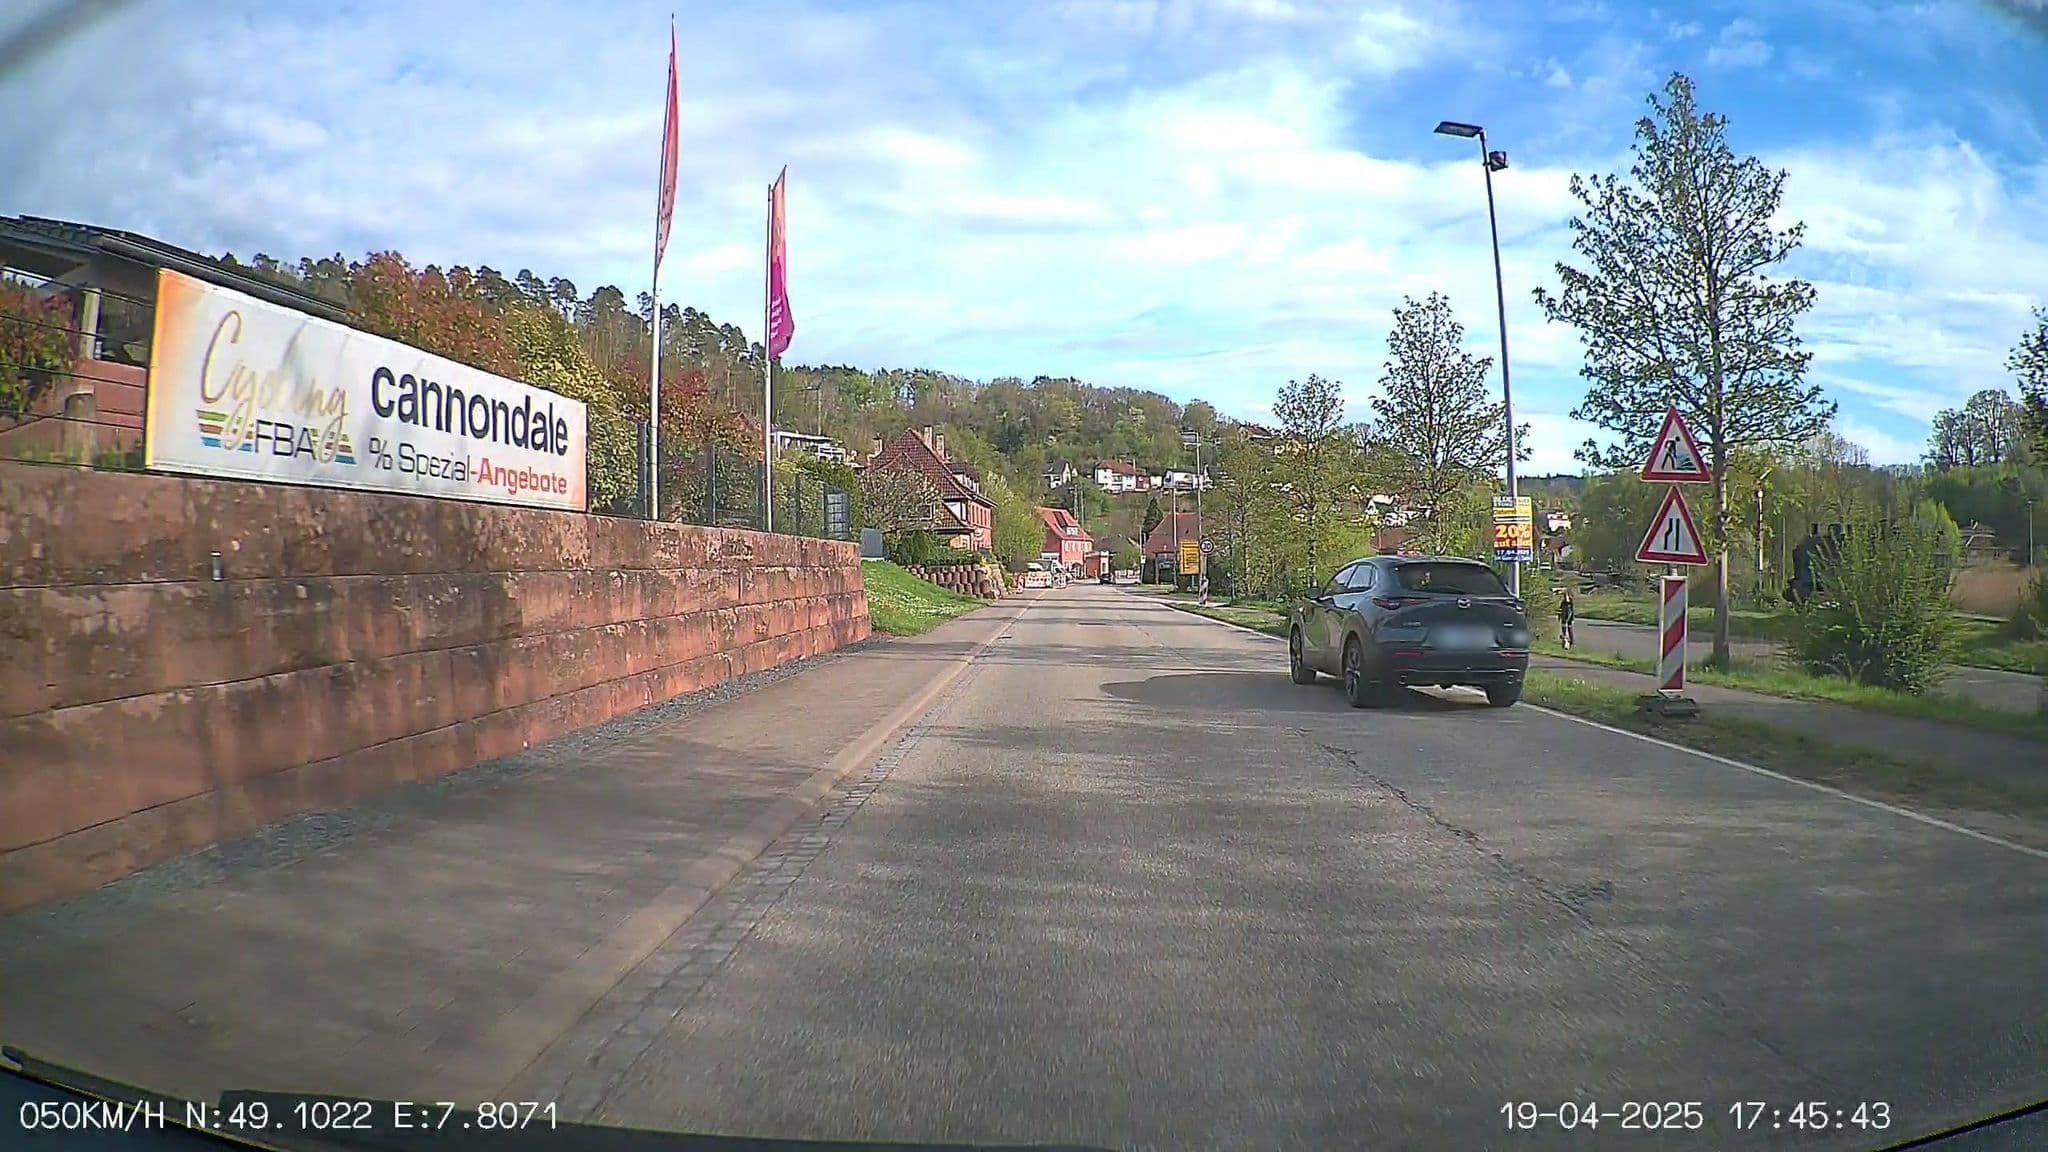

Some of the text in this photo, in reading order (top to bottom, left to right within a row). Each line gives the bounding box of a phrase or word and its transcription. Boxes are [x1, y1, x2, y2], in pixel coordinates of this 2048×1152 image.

[255, 418, 317, 461] FBA
[371, 366, 569, 457] cannondale
[368, 437, 567, 495] % Spezial-Angebote
